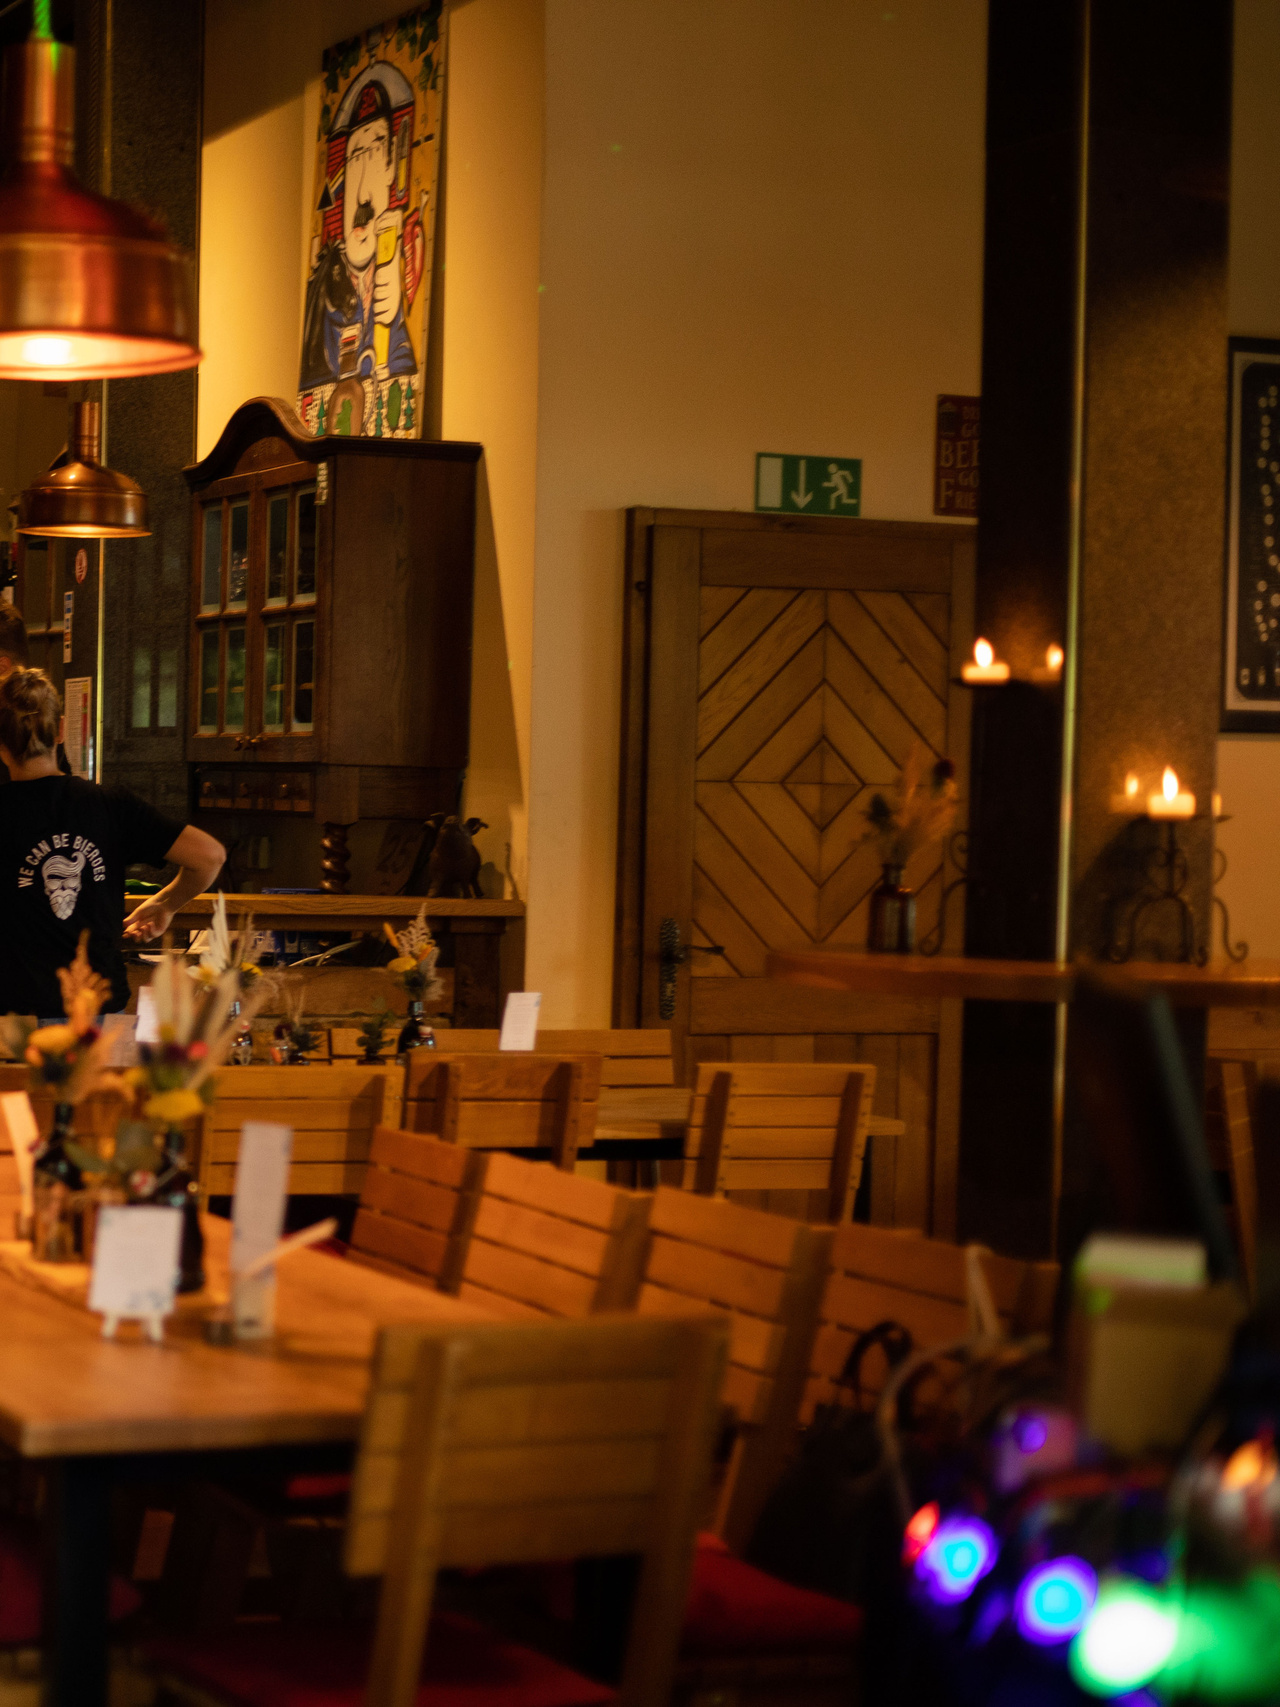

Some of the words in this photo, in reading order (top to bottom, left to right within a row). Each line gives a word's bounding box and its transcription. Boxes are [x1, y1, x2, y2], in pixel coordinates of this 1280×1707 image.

[51, 833, 70, 849] BE
[25, 840, 52, 866] CAN
[72, 836, 106, 882] BIEROES
[17, 867, 35, 888] WE
